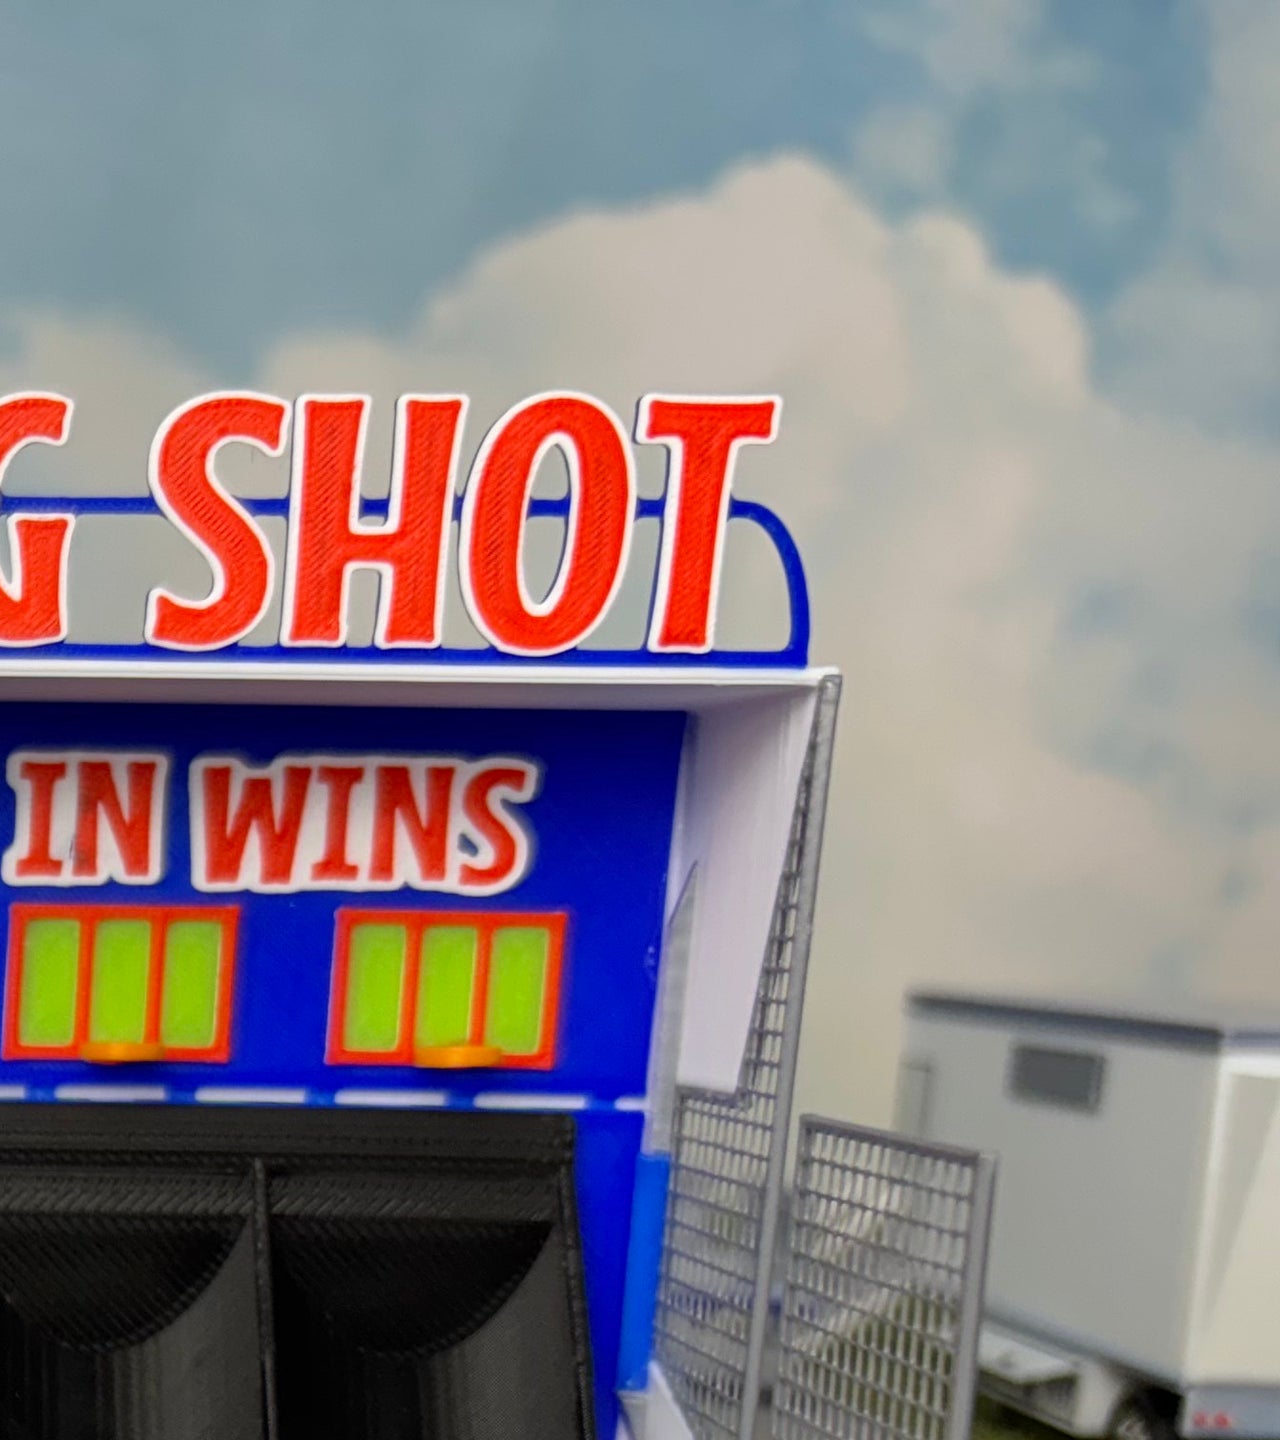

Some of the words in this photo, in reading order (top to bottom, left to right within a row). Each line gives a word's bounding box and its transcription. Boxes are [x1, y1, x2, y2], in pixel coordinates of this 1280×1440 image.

[151, 394, 778, 653] SHOT
[13, 758, 160, 880] IN
[199, 763, 529, 889] WINS
